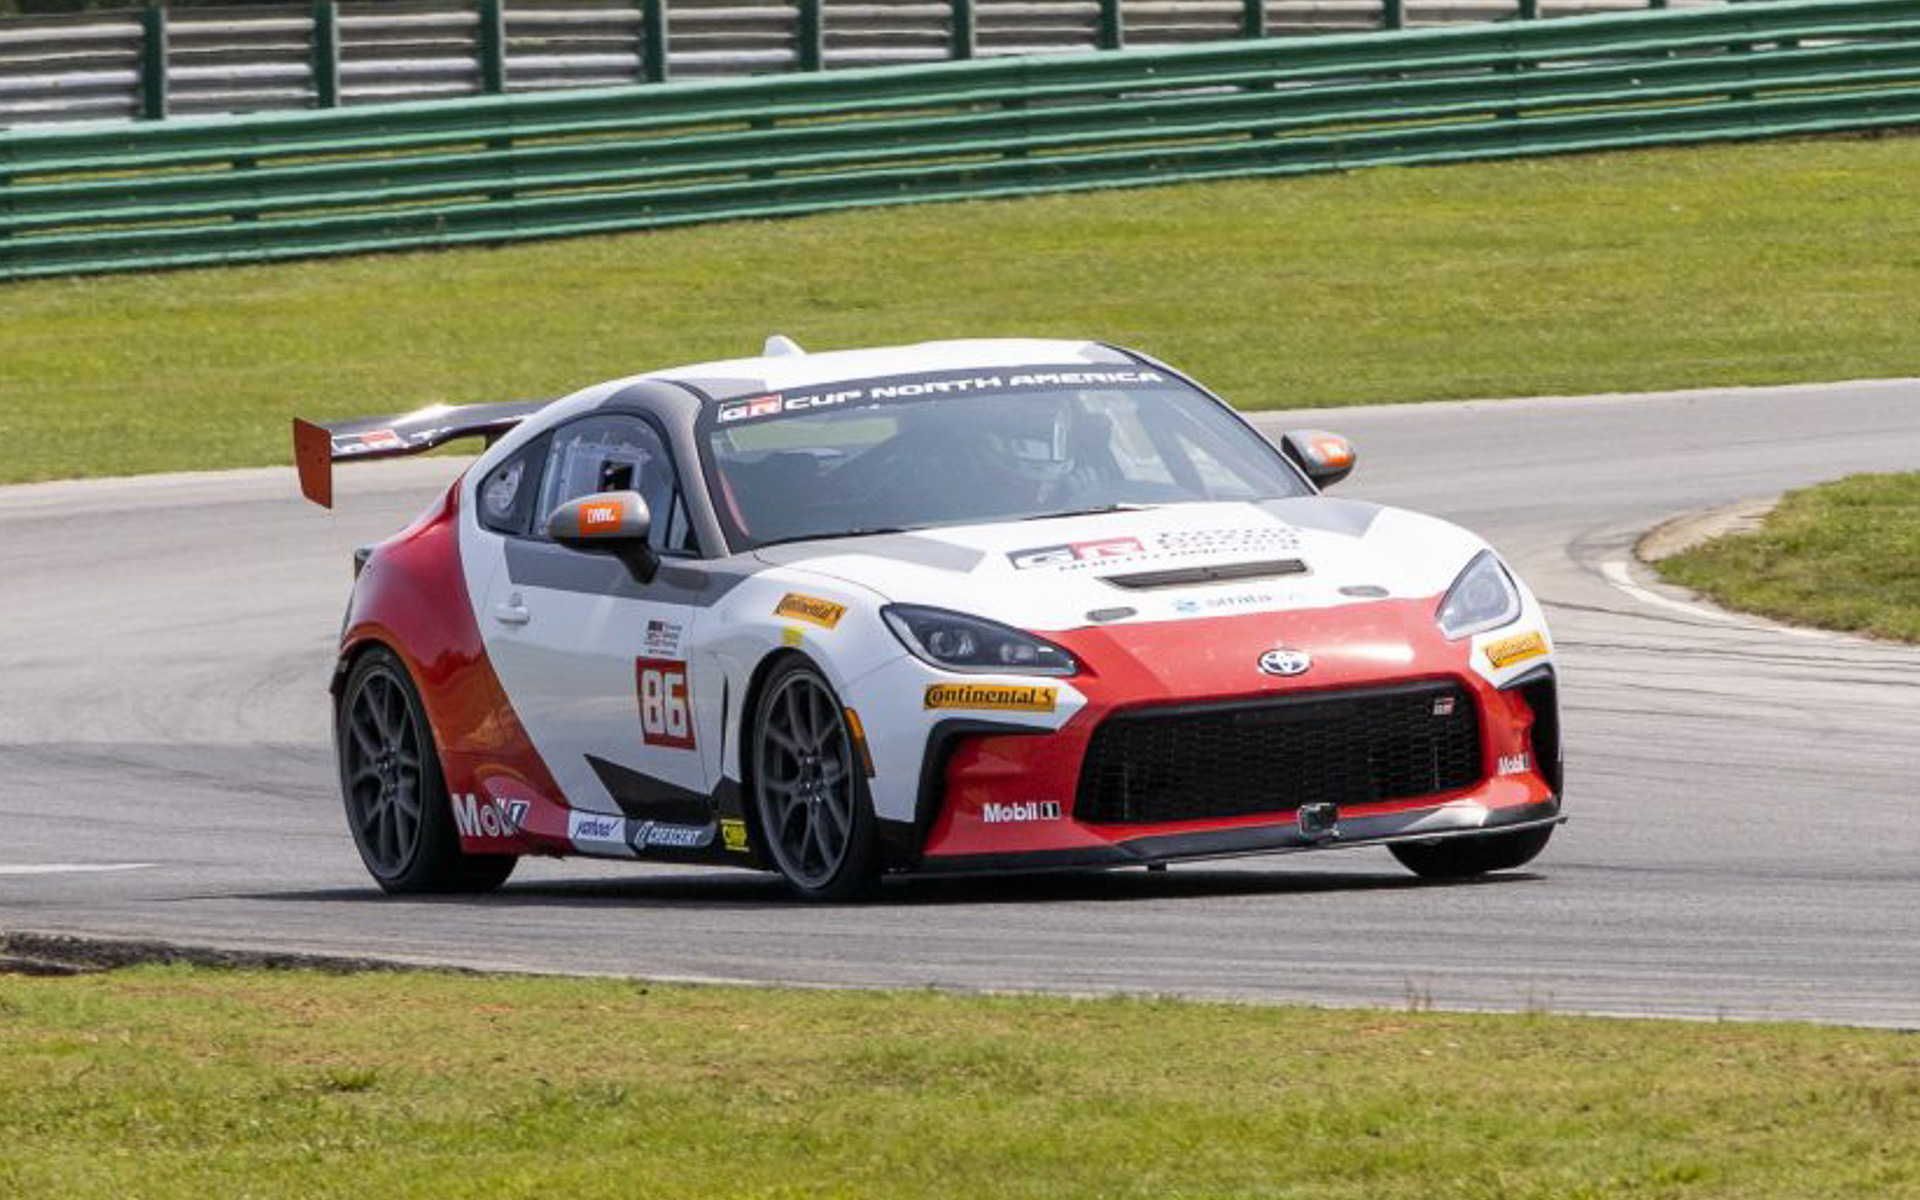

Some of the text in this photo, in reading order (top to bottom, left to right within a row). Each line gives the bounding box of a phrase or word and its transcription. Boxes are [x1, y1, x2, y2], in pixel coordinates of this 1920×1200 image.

[719, 372, 1163, 422] GR CUP NORTH AMERICA
[642, 669, 688, 737] 86
[925, 685, 1035, 708] Continental
[984, 802, 1039, 823] Mobil
[648, 827, 702, 846] CRESCENT
